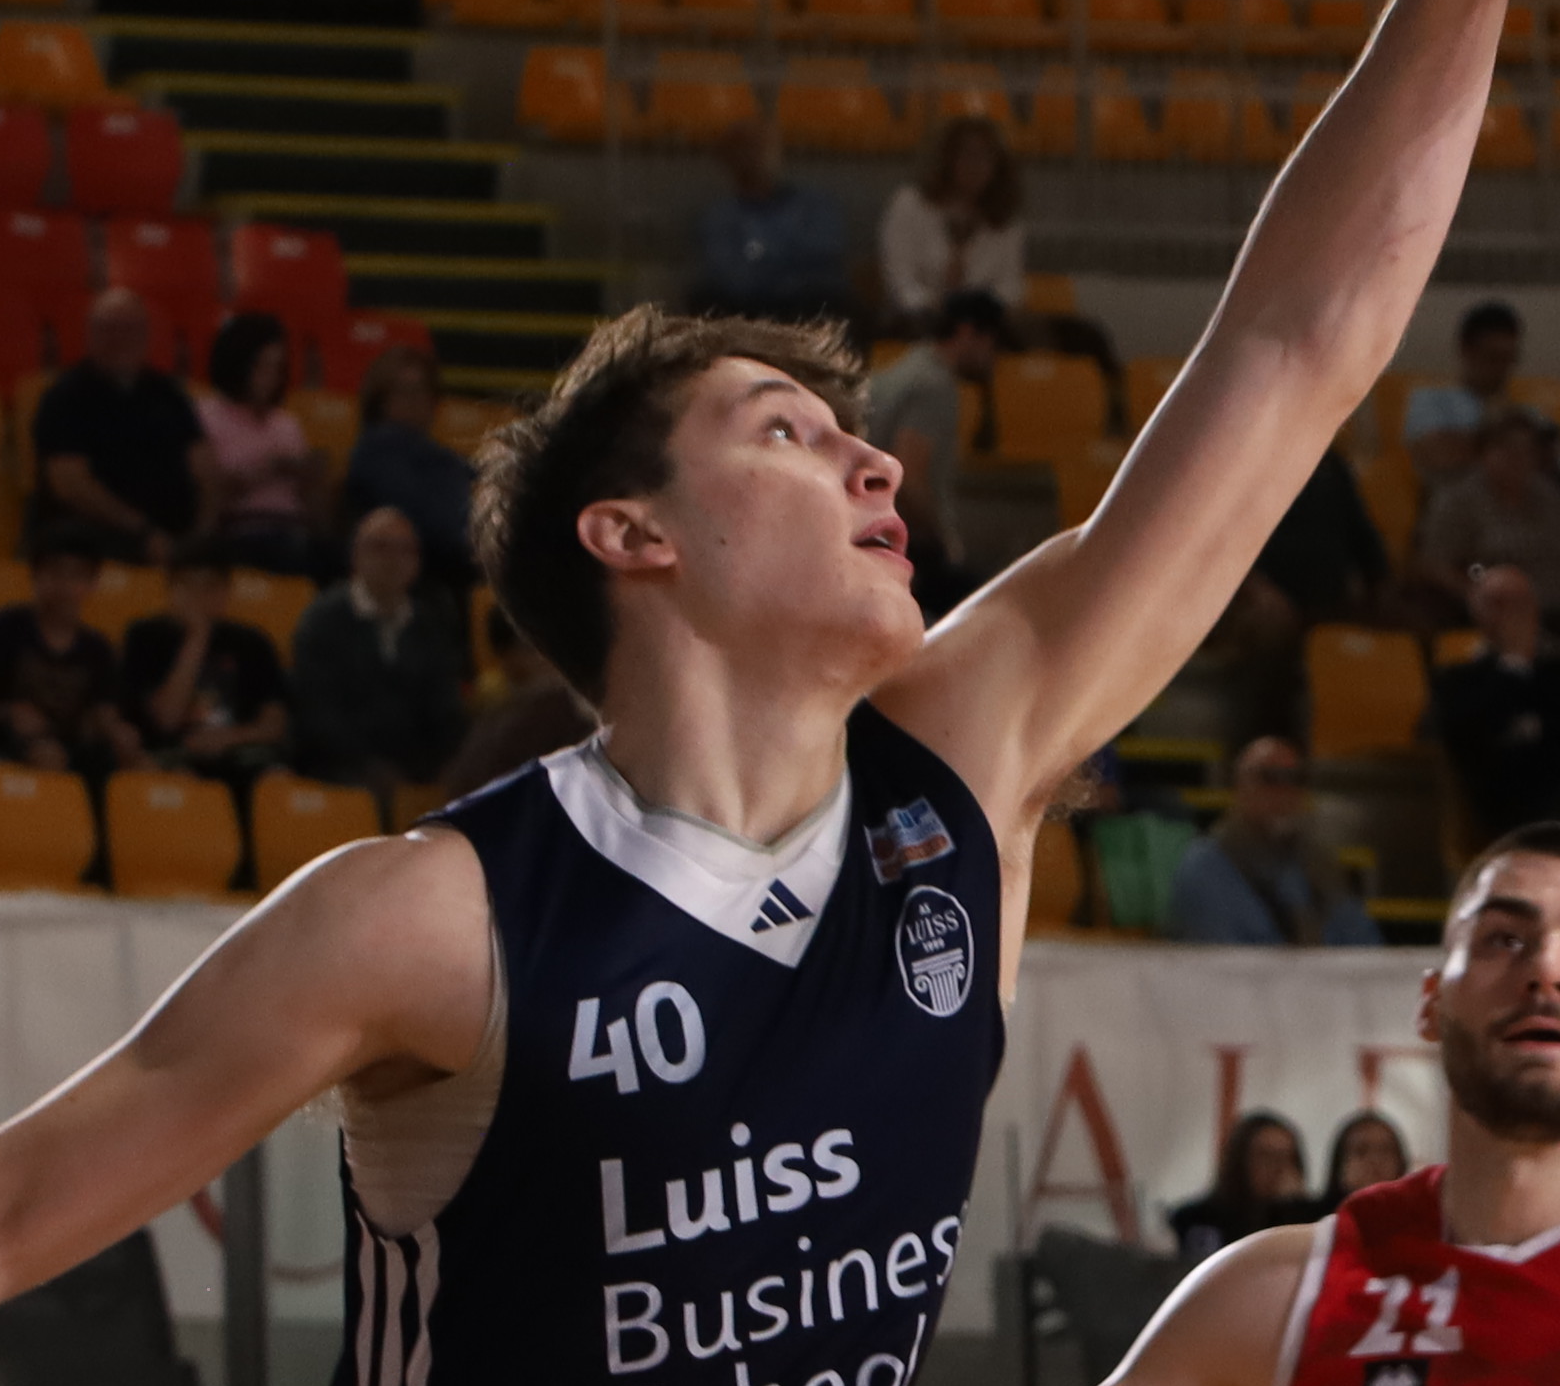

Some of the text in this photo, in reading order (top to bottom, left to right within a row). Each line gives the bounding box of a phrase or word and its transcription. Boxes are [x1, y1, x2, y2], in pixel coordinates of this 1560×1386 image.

[906, 910, 959, 945] LUISS
[568, 979, 707, 1095] 40
[600, 1122, 861, 1254] Luiss
[603, 1201, 970, 1375] Busines
[1348, 1265, 1464, 1358] 21
